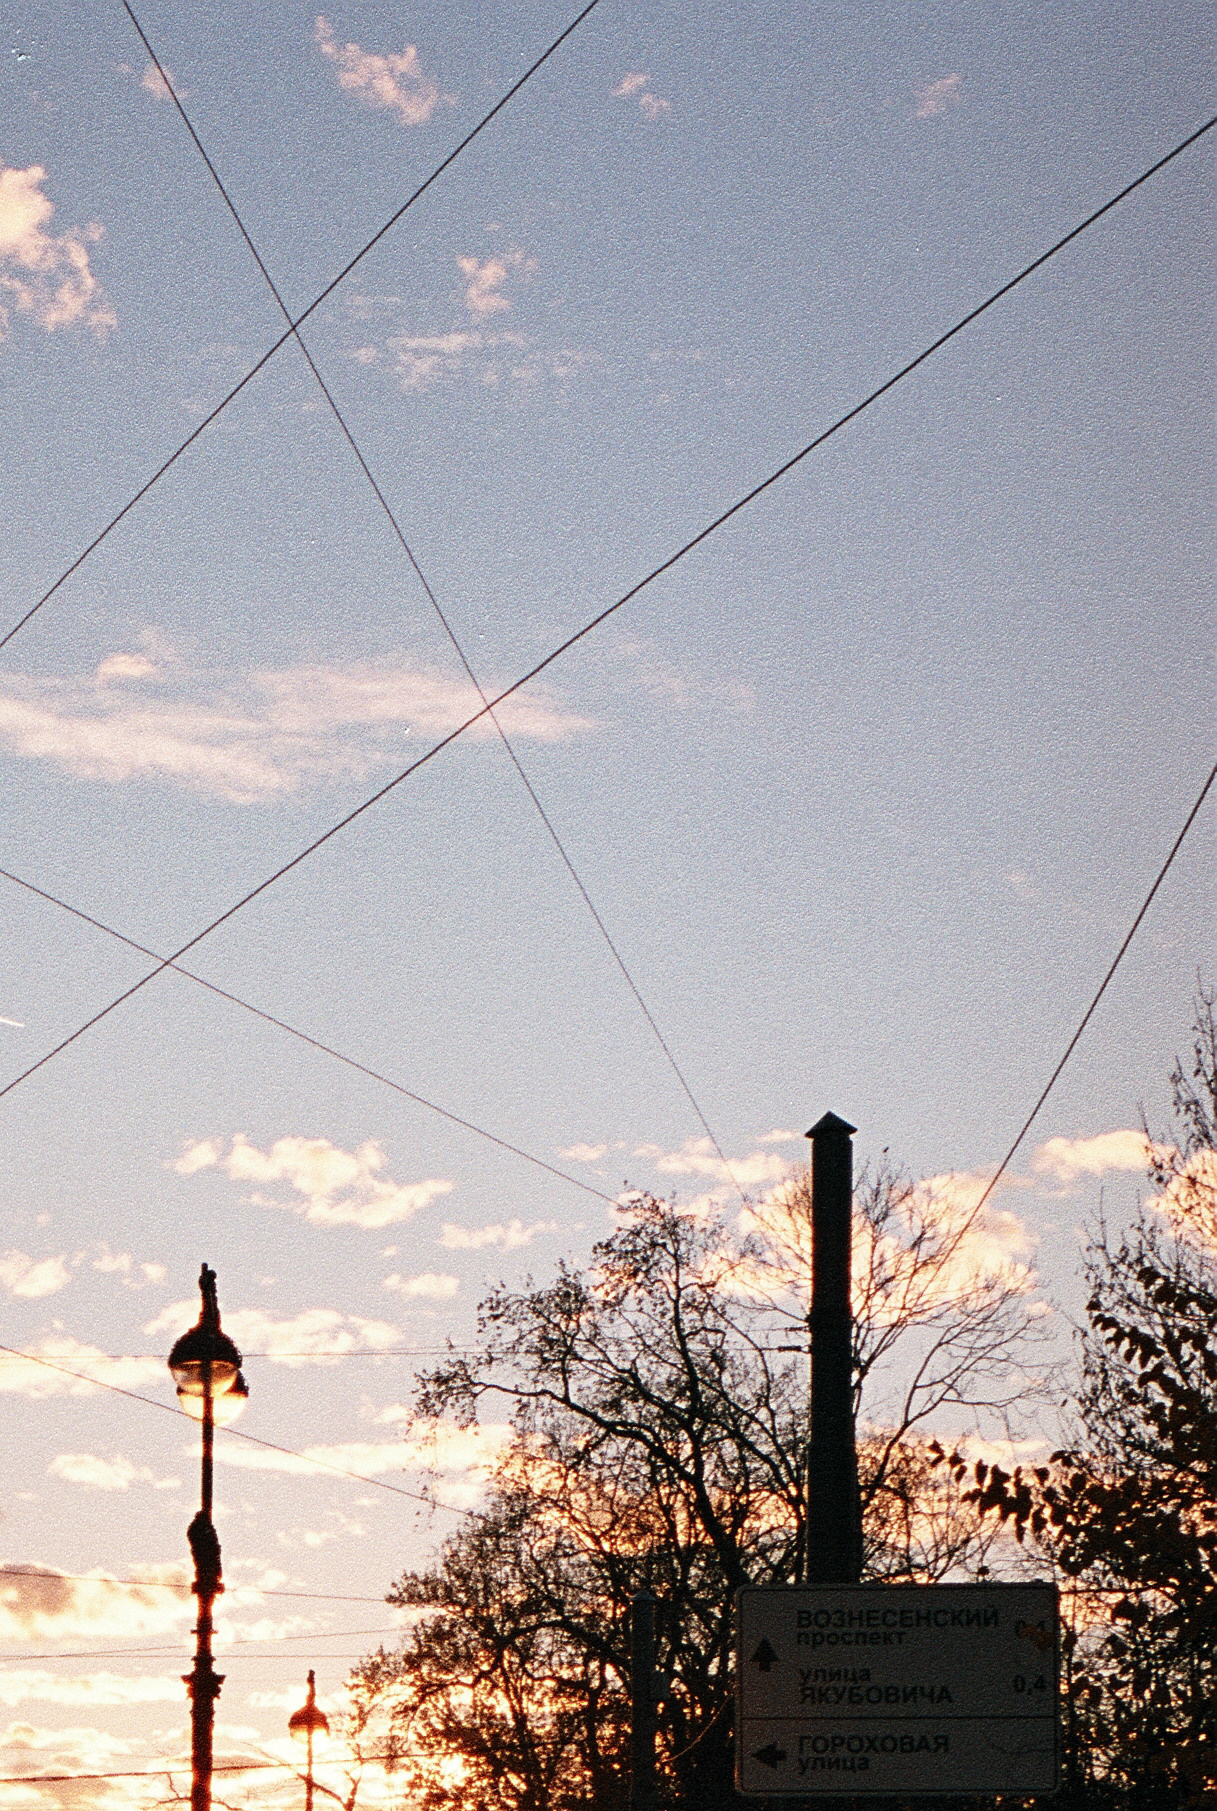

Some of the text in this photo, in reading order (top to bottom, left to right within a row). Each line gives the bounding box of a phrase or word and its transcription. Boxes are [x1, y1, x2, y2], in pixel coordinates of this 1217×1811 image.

[796, 1605, 1000, 1629] ВОЗНЕСЕНСКИЙ
[796, 1630, 906, 1648] проспект
[800, 1668, 871, 1686] улица
[1012, 1674, 1048, 1695] 0,4
[801, 1687, 953, 1704] ЯКУБОВИЧА
[798, 1736, 949, 1753] ГОРОХОВАЯ
[797, 1754, 870, 1774] улица
